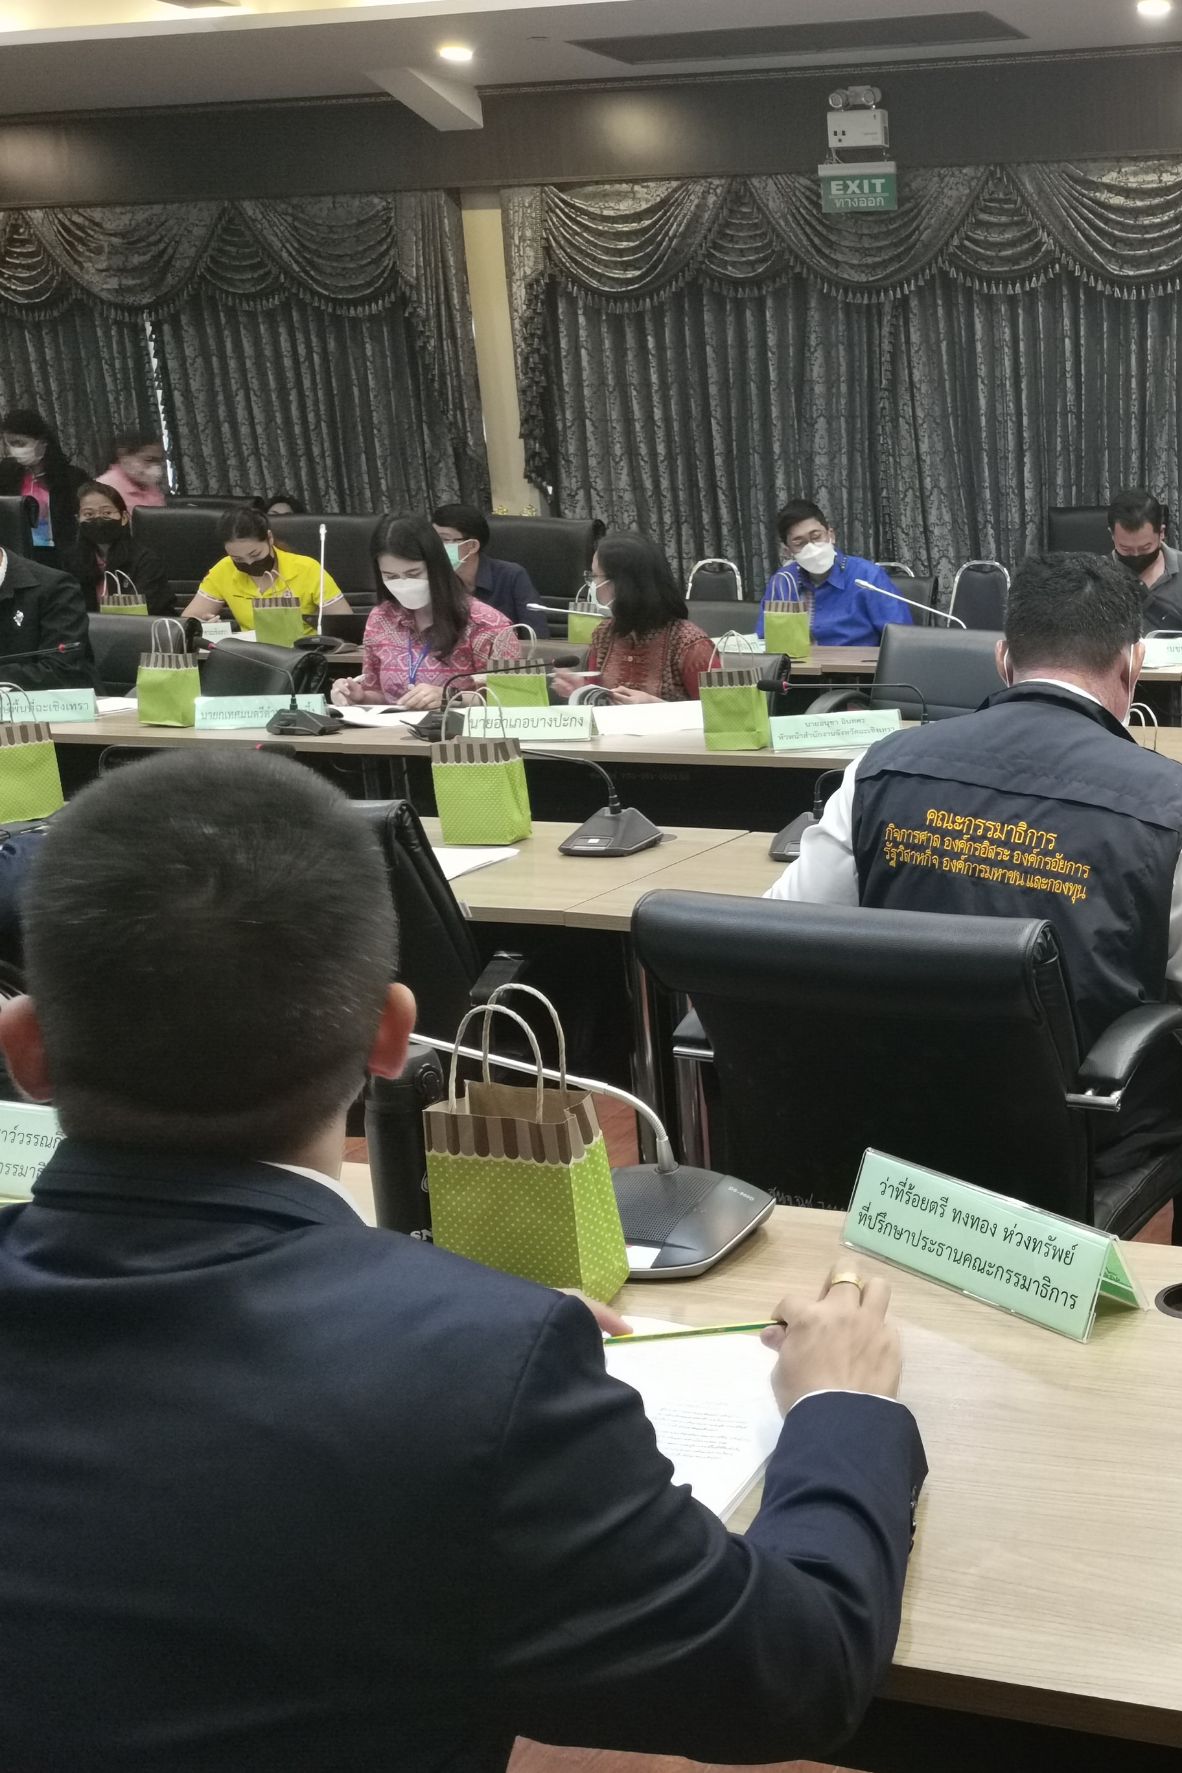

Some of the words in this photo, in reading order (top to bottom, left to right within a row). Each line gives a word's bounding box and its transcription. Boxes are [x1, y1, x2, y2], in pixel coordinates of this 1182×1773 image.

[830, 178, 886, 195] EXIT
[834, 196, 885, 209] ทางออก
[926, 808, 1058, 850] คณะกรรมาธิการ
[883, 841, 939, 869] รัฐวิสาหกิจ
[885, 823, 941, 849] กิจการศาล
[943, 834, 1010, 861] องค์กรอิสระ
[1013, 849, 1091, 879] องค์กรอัยการ
[879, 1176, 949, 1219] ว่าที่ร้อยตรี
[952, 1207, 998, 1238] ทงทอง
[1002, 1223, 1079, 1266] ห่วงทรัพย์
[857, 1202, 1079, 1310] ที่ปรึกษาประธานคณะกรรมาธิการ
